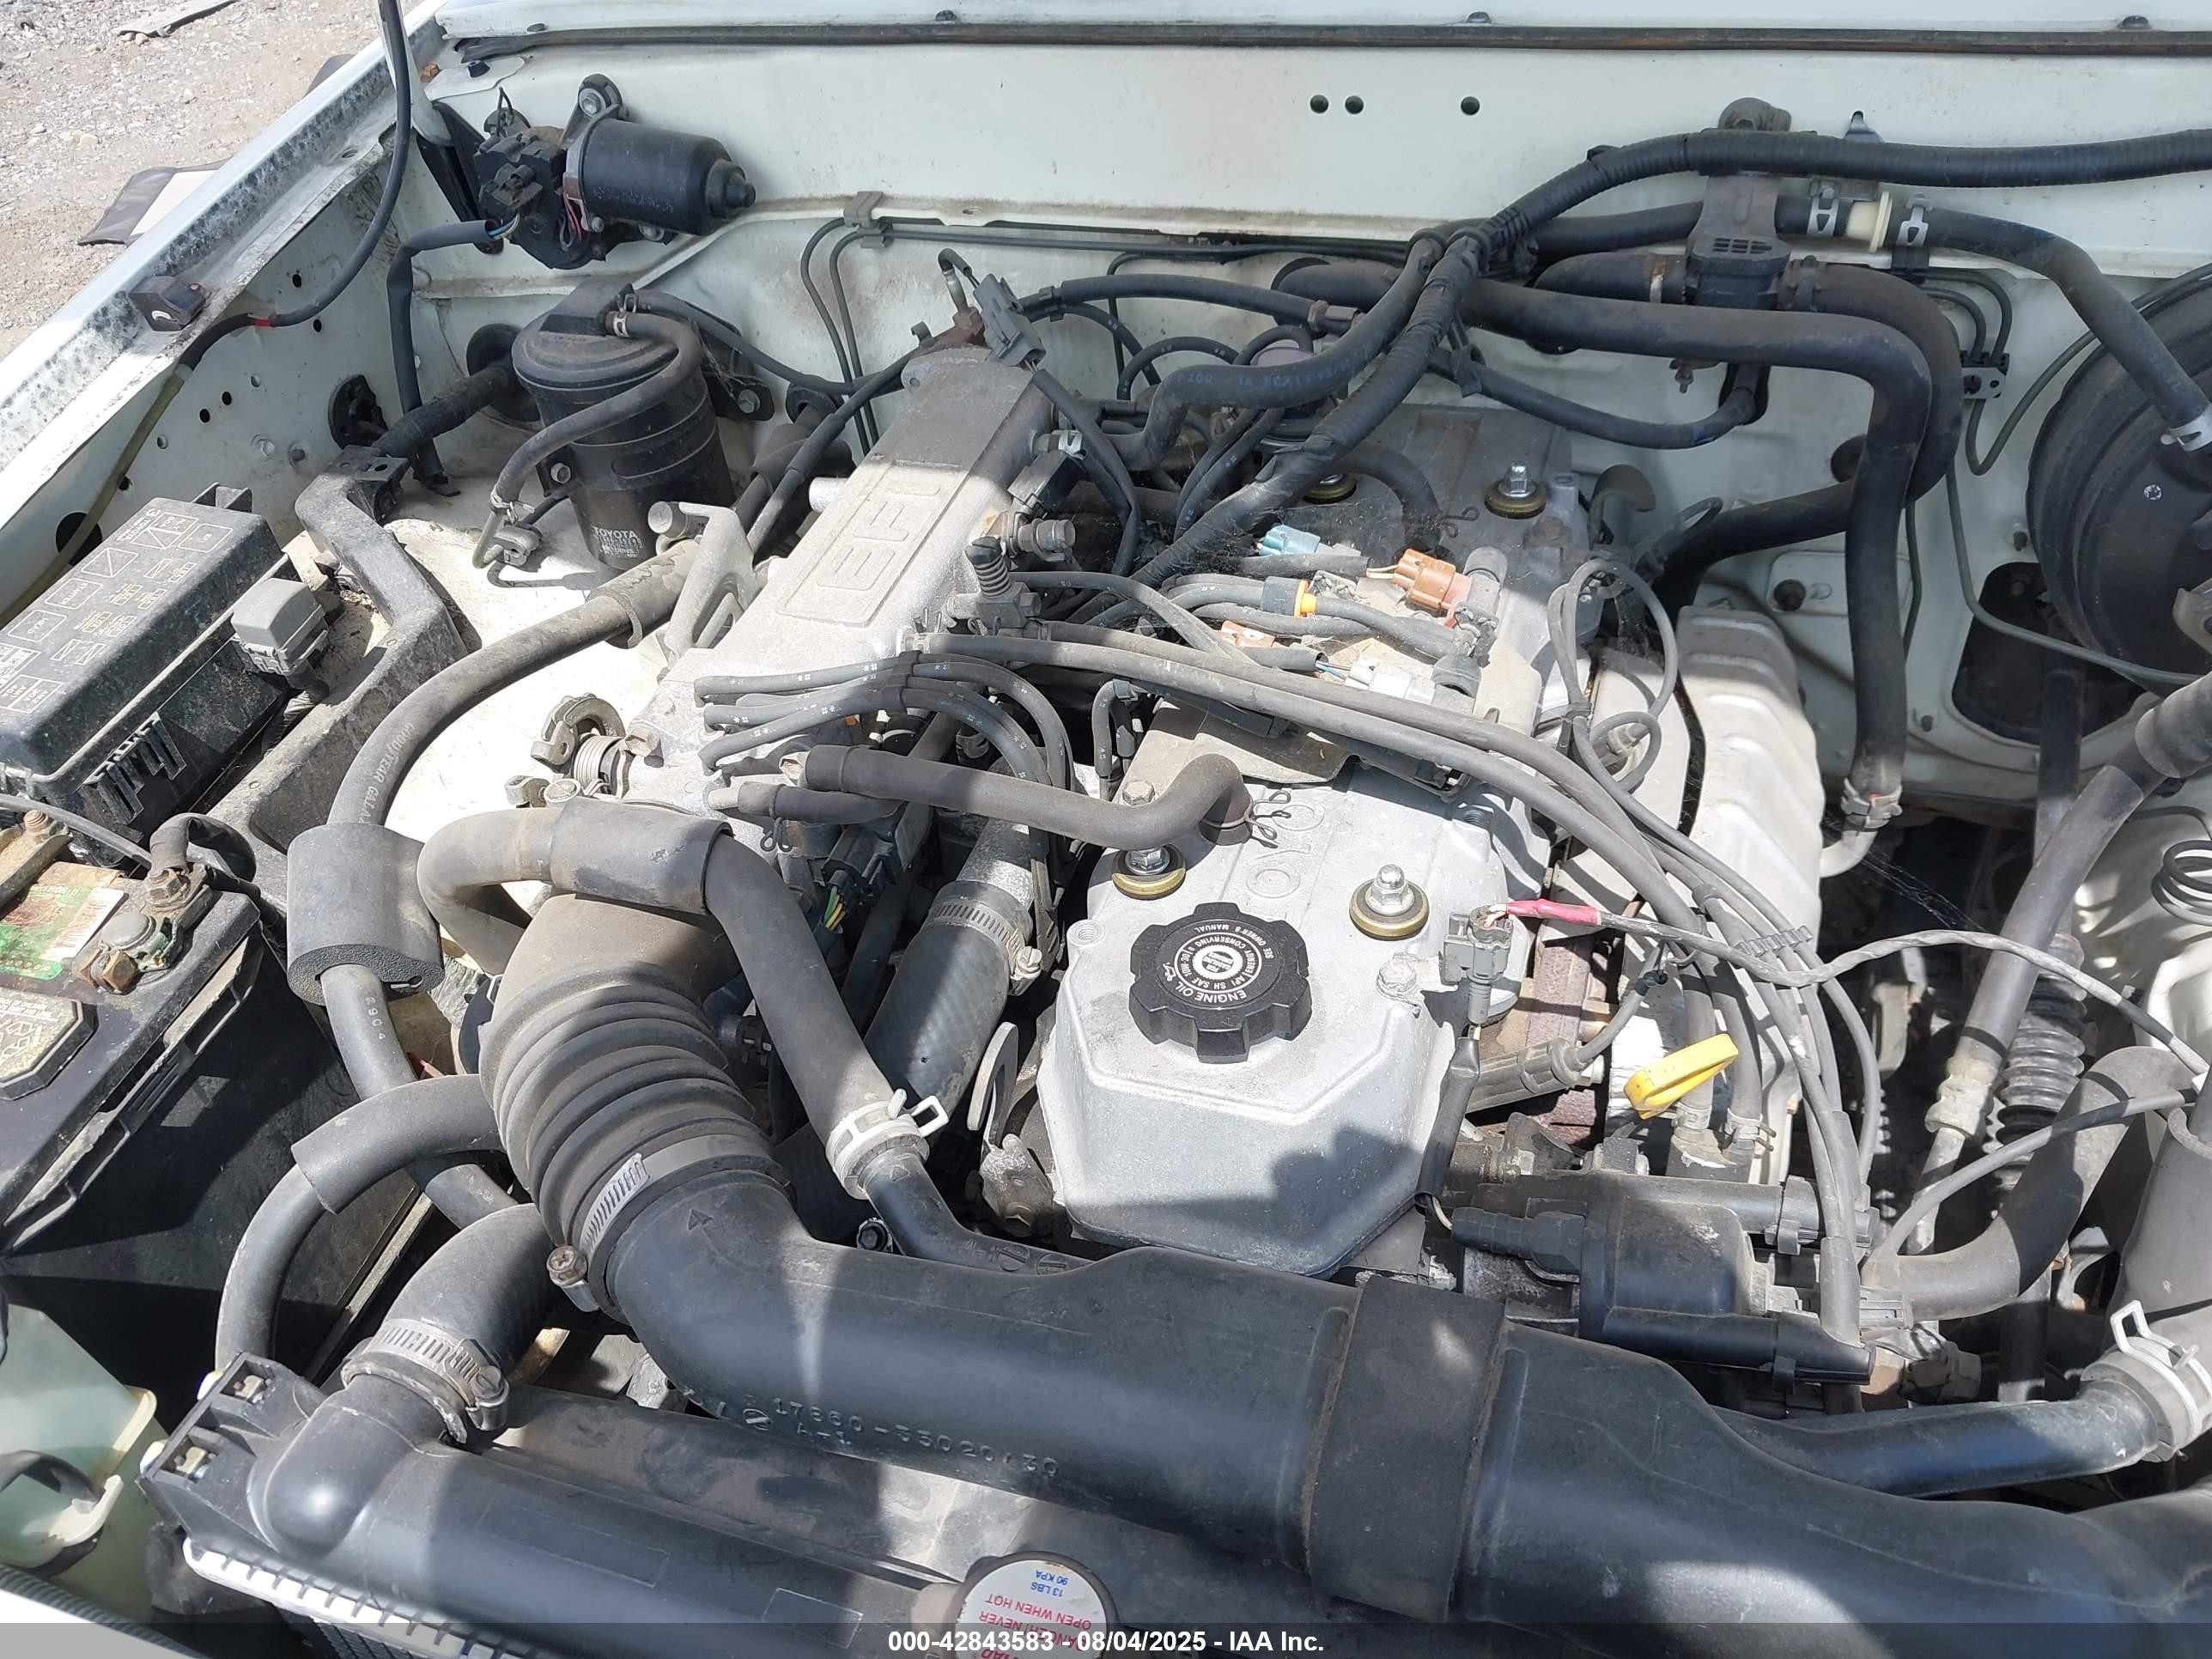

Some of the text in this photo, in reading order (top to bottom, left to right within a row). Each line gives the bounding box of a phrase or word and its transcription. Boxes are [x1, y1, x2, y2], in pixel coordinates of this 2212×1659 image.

[592, 526, 638, 539] TOYOTA
[1194, 924, 1230, 933] MANUAL
[1194, 936, 1246, 949] CONSERVING
[1263, 947, 1273, 959] SEE
[1244, 950, 1255, 975] ENERGY
[1192, 977, 1210, 988] SAE
[1231, 975, 1245, 987] API
[1176, 981, 1247, 1003] ENGINE OIL
[1036, 1571, 1068, 1585] 90 KPA
[1030, 1582, 1063, 1597] 13 LBS
[985, 1594, 1091, 1630] OPEN WHEN HOT
[979, 1611, 1022, 1632] NEVER
